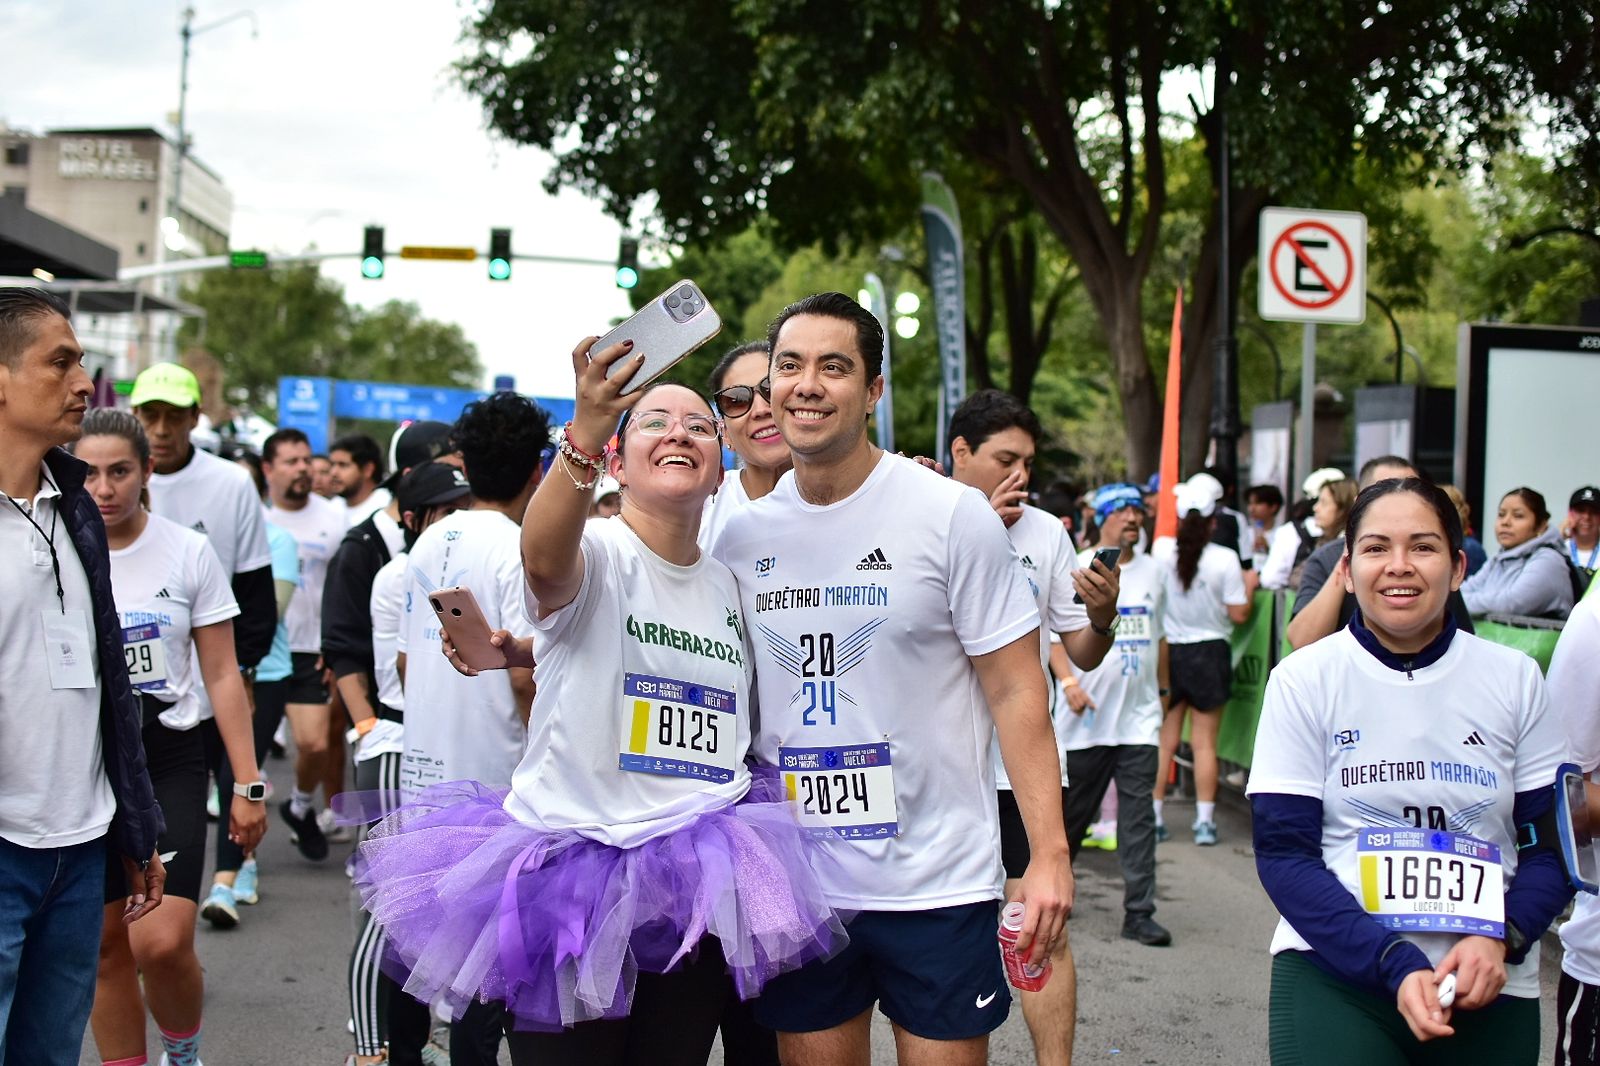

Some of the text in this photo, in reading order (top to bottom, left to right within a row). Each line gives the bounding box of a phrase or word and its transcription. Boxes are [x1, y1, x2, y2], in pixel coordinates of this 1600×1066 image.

[60, 139, 138, 159] HOTEL
[856, 562, 893, 571] adidas
[755, 583, 888, 613] QUERÉTARO MARATÓN
[125, 644, 152, 675] 29
[800, 633, 835, 677] 20
[802, 681, 836, 725] 24
[658, 705, 718, 754] 8125
[843, 755, 866, 766] VUELA
[1341, 760, 1498, 789] QUERÉTARO MARATÓN
[801, 772, 869, 815] 2024
[1454, 842, 1478, 857] VUELA
[1384, 856, 1485, 905] 16637
[1413, 901, 1456, 913] LUCERO 13
